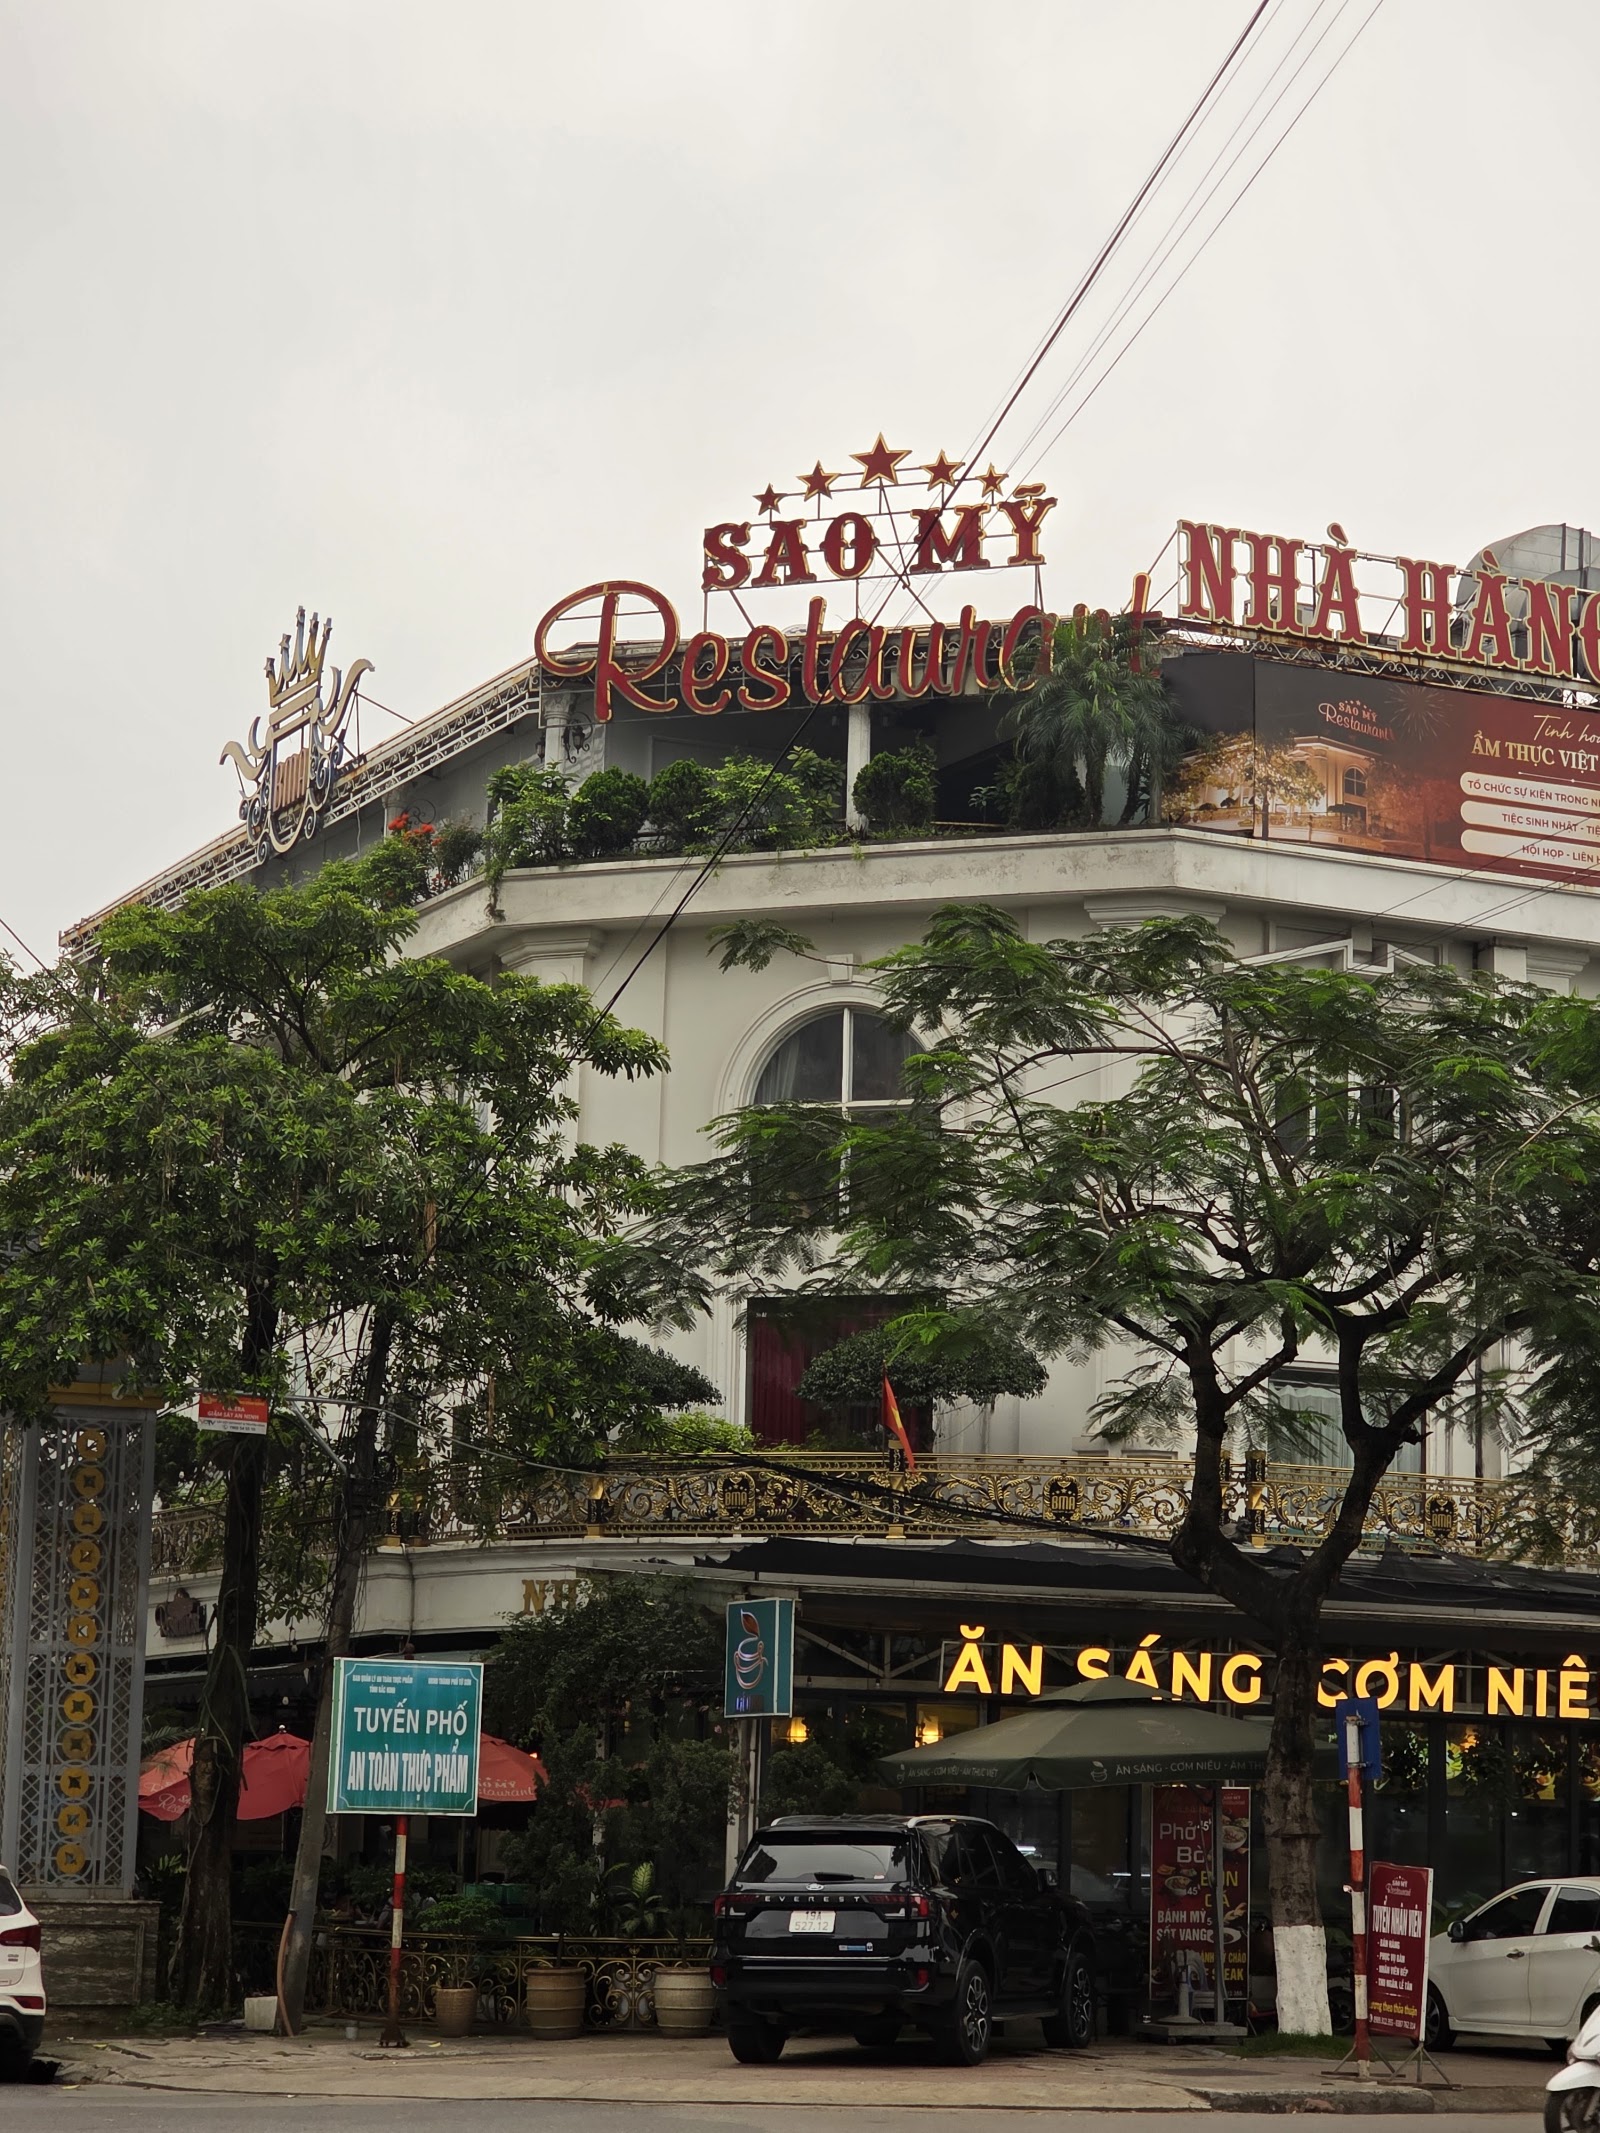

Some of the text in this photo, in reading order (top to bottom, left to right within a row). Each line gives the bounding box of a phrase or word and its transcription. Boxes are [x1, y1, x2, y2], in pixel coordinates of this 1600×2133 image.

[703, 482, 1059, 592] SAO MỸ
[1177, 518, 1368, 646] NHÀ
[1338, 701, 1359, 716] SAO
[1471, 729, 1599, 774] ẨM THỰC VIỆT
[1483, 782, 1512, 795] CHỨC
[1513, 786, 1528, 799] SỰ
[1529, 788, 1553, 802] KIỆN
[1555, 792, 1589, 806] TRONG
[1502, 812, 1524, 826] TIỆC
[1525, 816, 1549, 829] SINH
[1551, 820, 1579, 834] NHẬT
[1522, 845, 1540, 857] HỘI
[1543, 848, 1564, 861] HỌP
[1572, 850, 1594, 864] LIÊN
[1051, 1495, 1076, 1510] BMA
[943, 1624, 1044, 1696] ĂN
[1076, 1633, 1263, 1704] SÁNG
[1317, 1651, 1455, 1713] CƠM
[354, 1698, 468, 1736] TUYẾN PHỐ
[347, 1738, 469, 1801] AN TOÀN THỰC PHẨM
[1133, 1762, 1163, 1774] SÁNG
[764, 1895, 861, 1903] EVEREST
[1157, 1908, 1187, 1923] BÁNH
[1179, 1928, 1208, 1941] VANG
